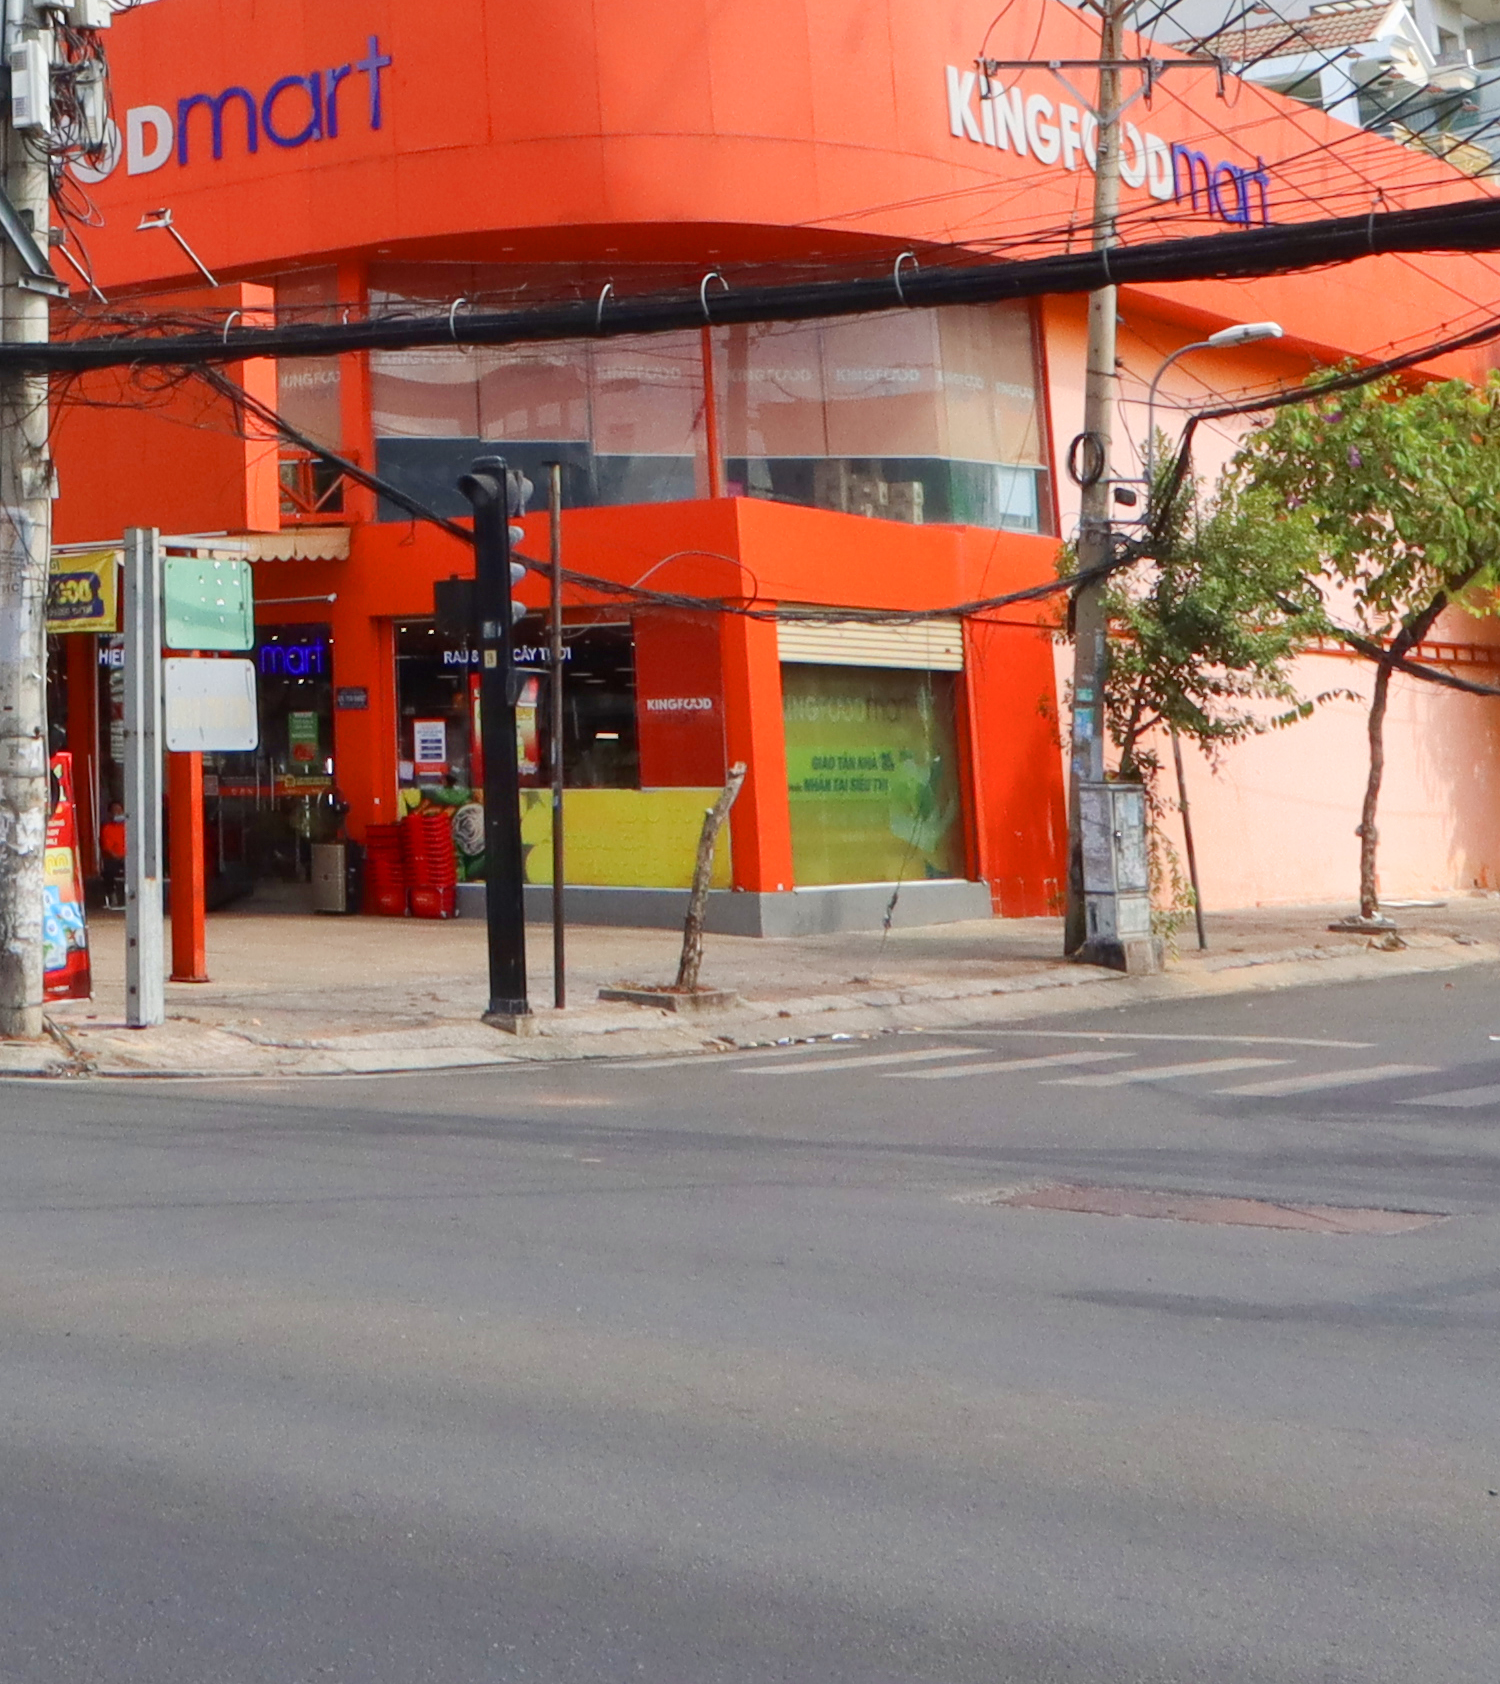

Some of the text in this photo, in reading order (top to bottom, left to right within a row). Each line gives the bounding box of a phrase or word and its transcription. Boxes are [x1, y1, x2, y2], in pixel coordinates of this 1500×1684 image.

[260, 637, 324, 675] mart
[443, 649, 469, 664] RAU
[513, 645, 537, 662] CÂY
[646, 697, 713, 711] KINGFOOD
